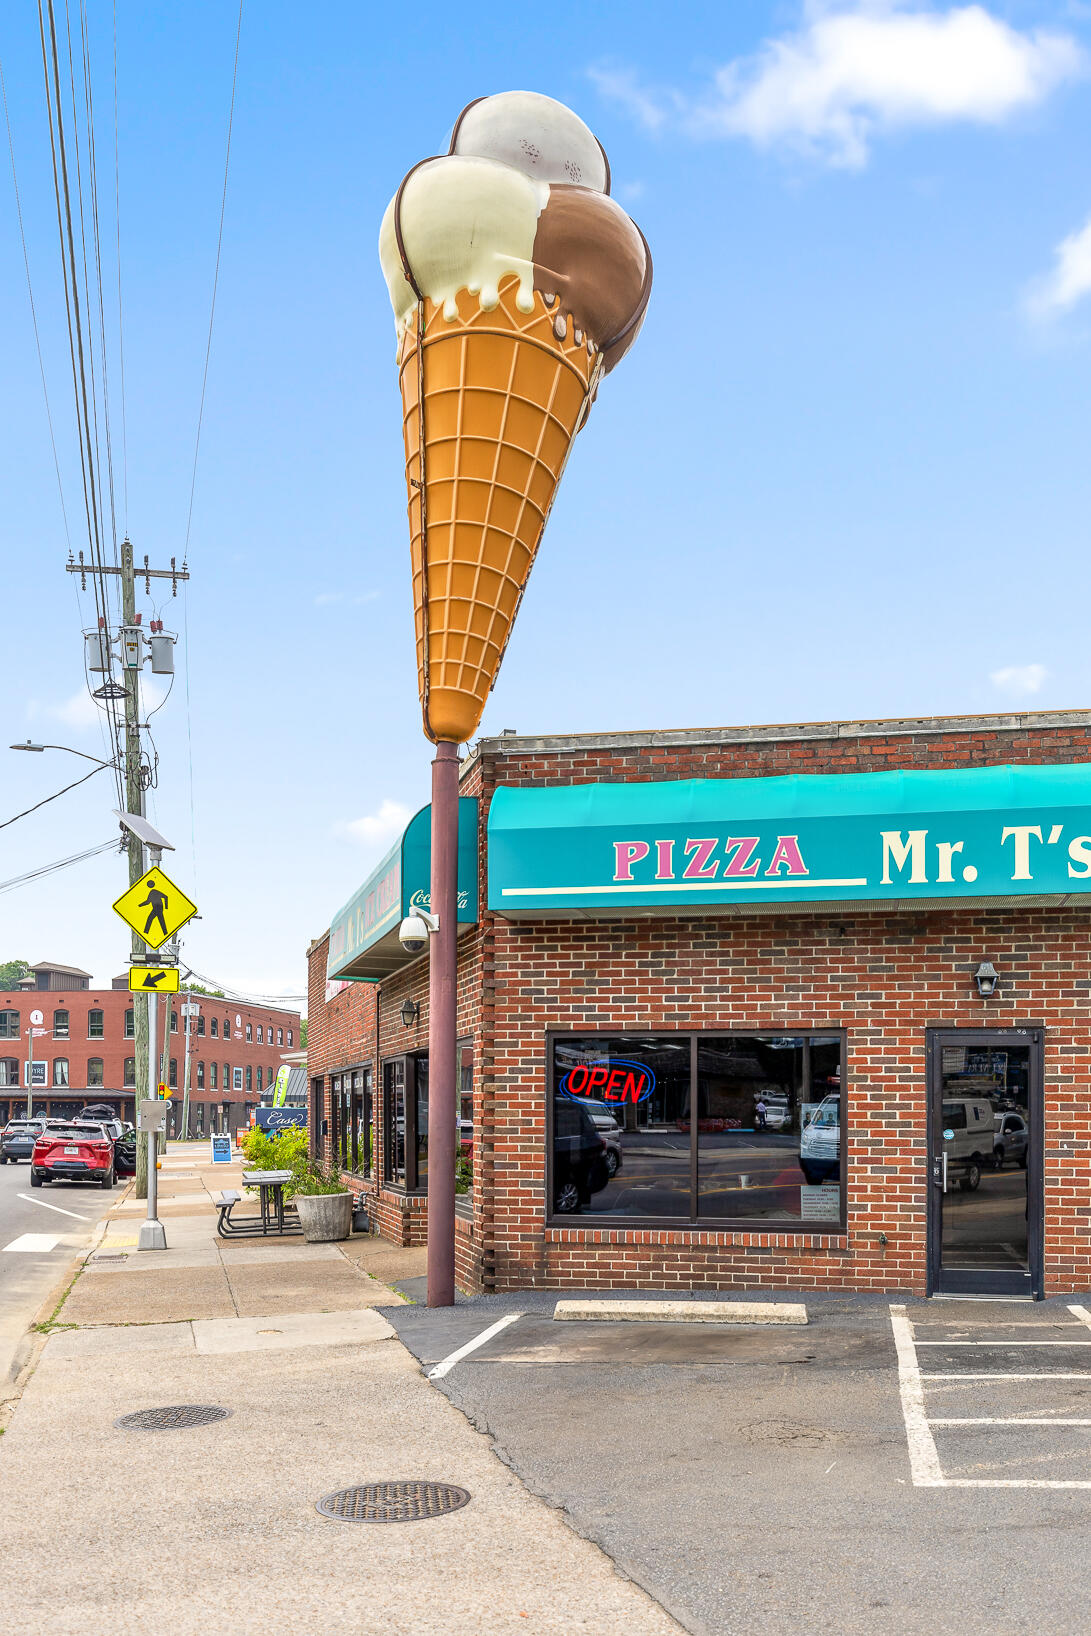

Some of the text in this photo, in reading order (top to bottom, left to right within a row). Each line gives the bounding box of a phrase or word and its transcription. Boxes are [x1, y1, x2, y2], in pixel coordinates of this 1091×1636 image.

[612, 835, 810, 881] PIZZA
[879, 829, 979, 884] Mr.
[568, 1065, 646, 1104] OPEN
